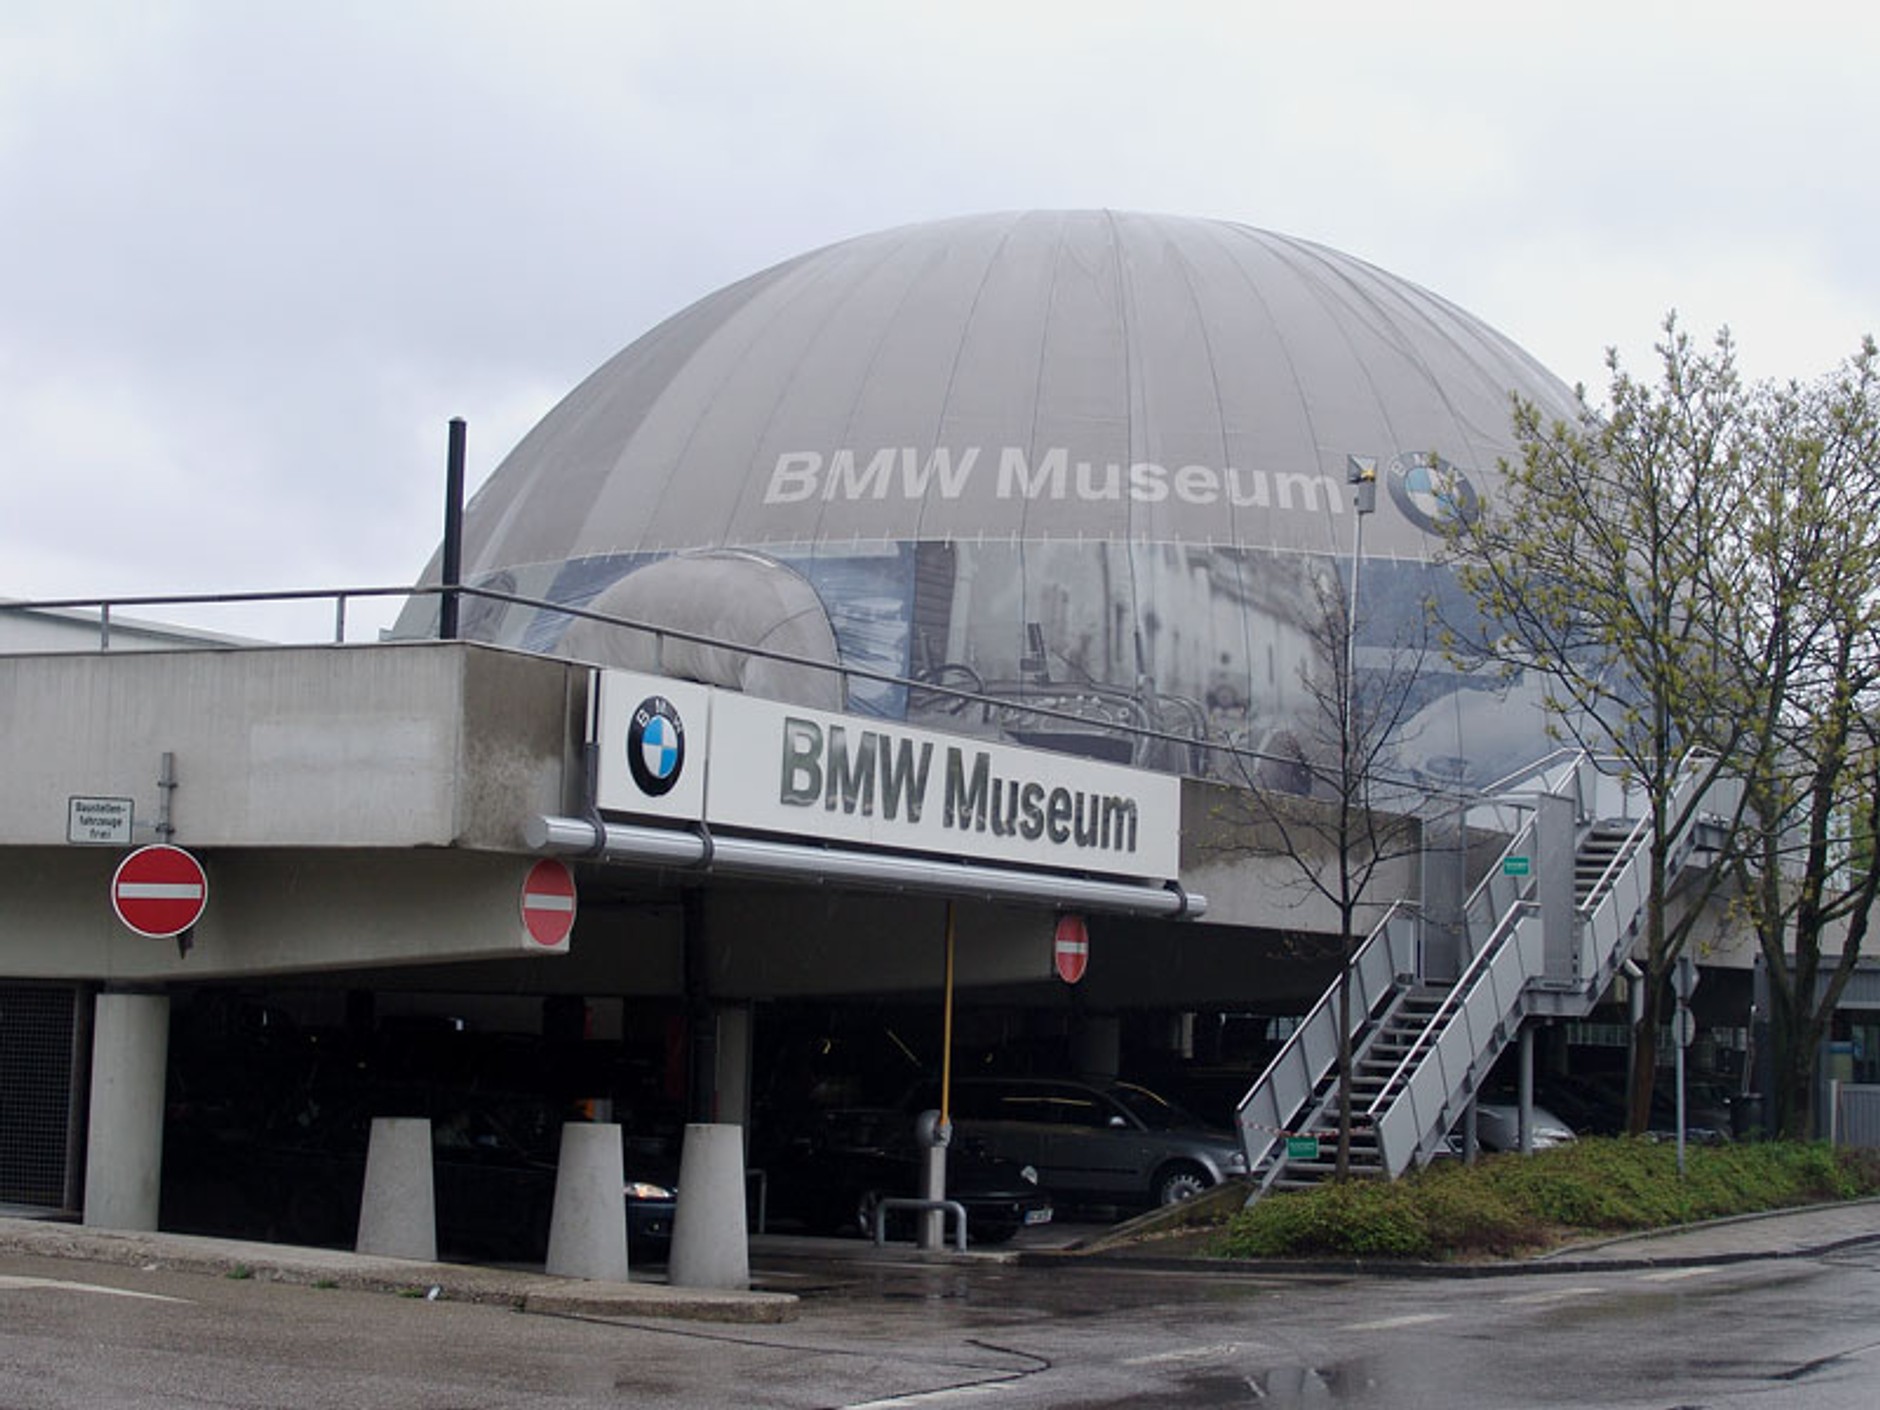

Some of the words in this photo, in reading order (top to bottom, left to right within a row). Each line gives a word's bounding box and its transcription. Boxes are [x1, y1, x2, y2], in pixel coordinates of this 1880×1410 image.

[763, 447, 981, 505] BMW
[995, 448, 1345, 513] Museum
[632, 698, 682, 733] BMW
[780, 716, 934, 824] BMW
[942, 746, 1138, 853] Museum
[75, 801, 126, 814] Baustellen-
[89, 828, 112, 839] frei
